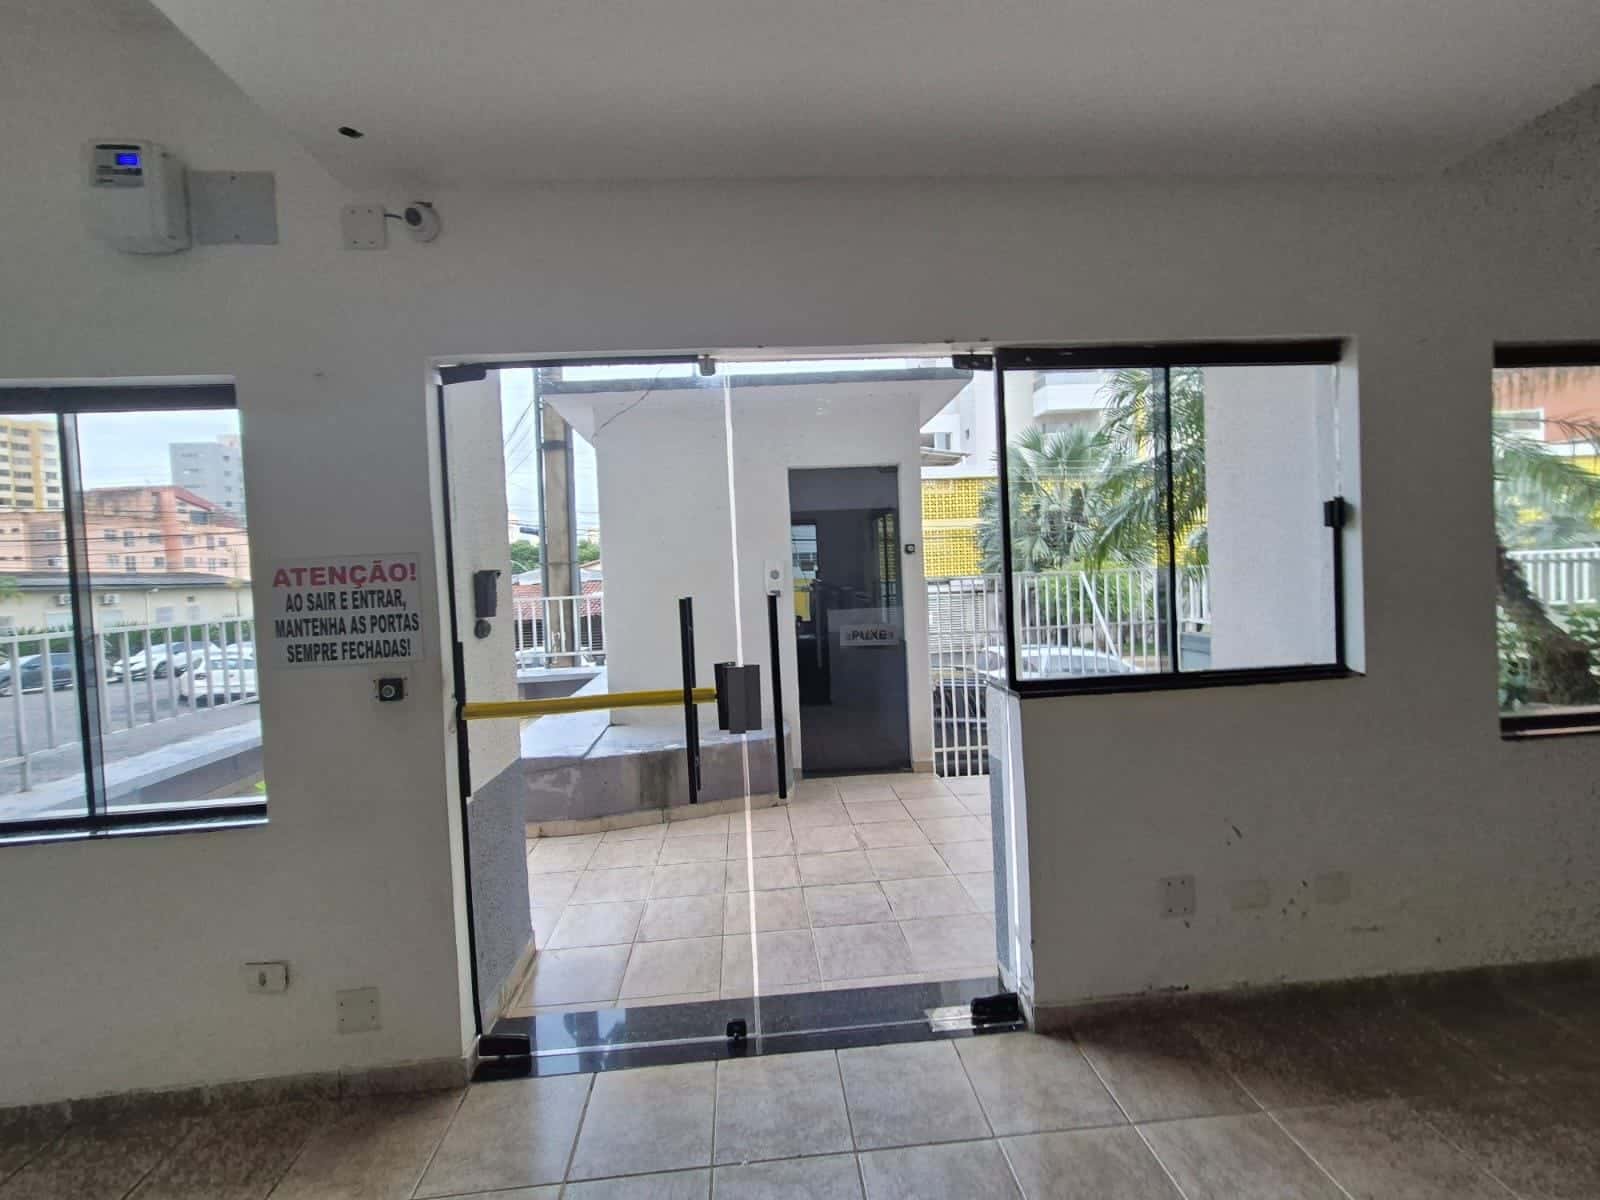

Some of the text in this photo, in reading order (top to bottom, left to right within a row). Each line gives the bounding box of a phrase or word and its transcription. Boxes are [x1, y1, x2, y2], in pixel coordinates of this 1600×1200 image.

[272, 560, 417, 589] ATENÇÃO!
[286, 588, 407, 612] AO SAIR E ENTRAR,
[274, 612, 420, 639] MANTENHA AS PORTAS
[287, 638, 412, 663] SEMPRE FECHADAS!
